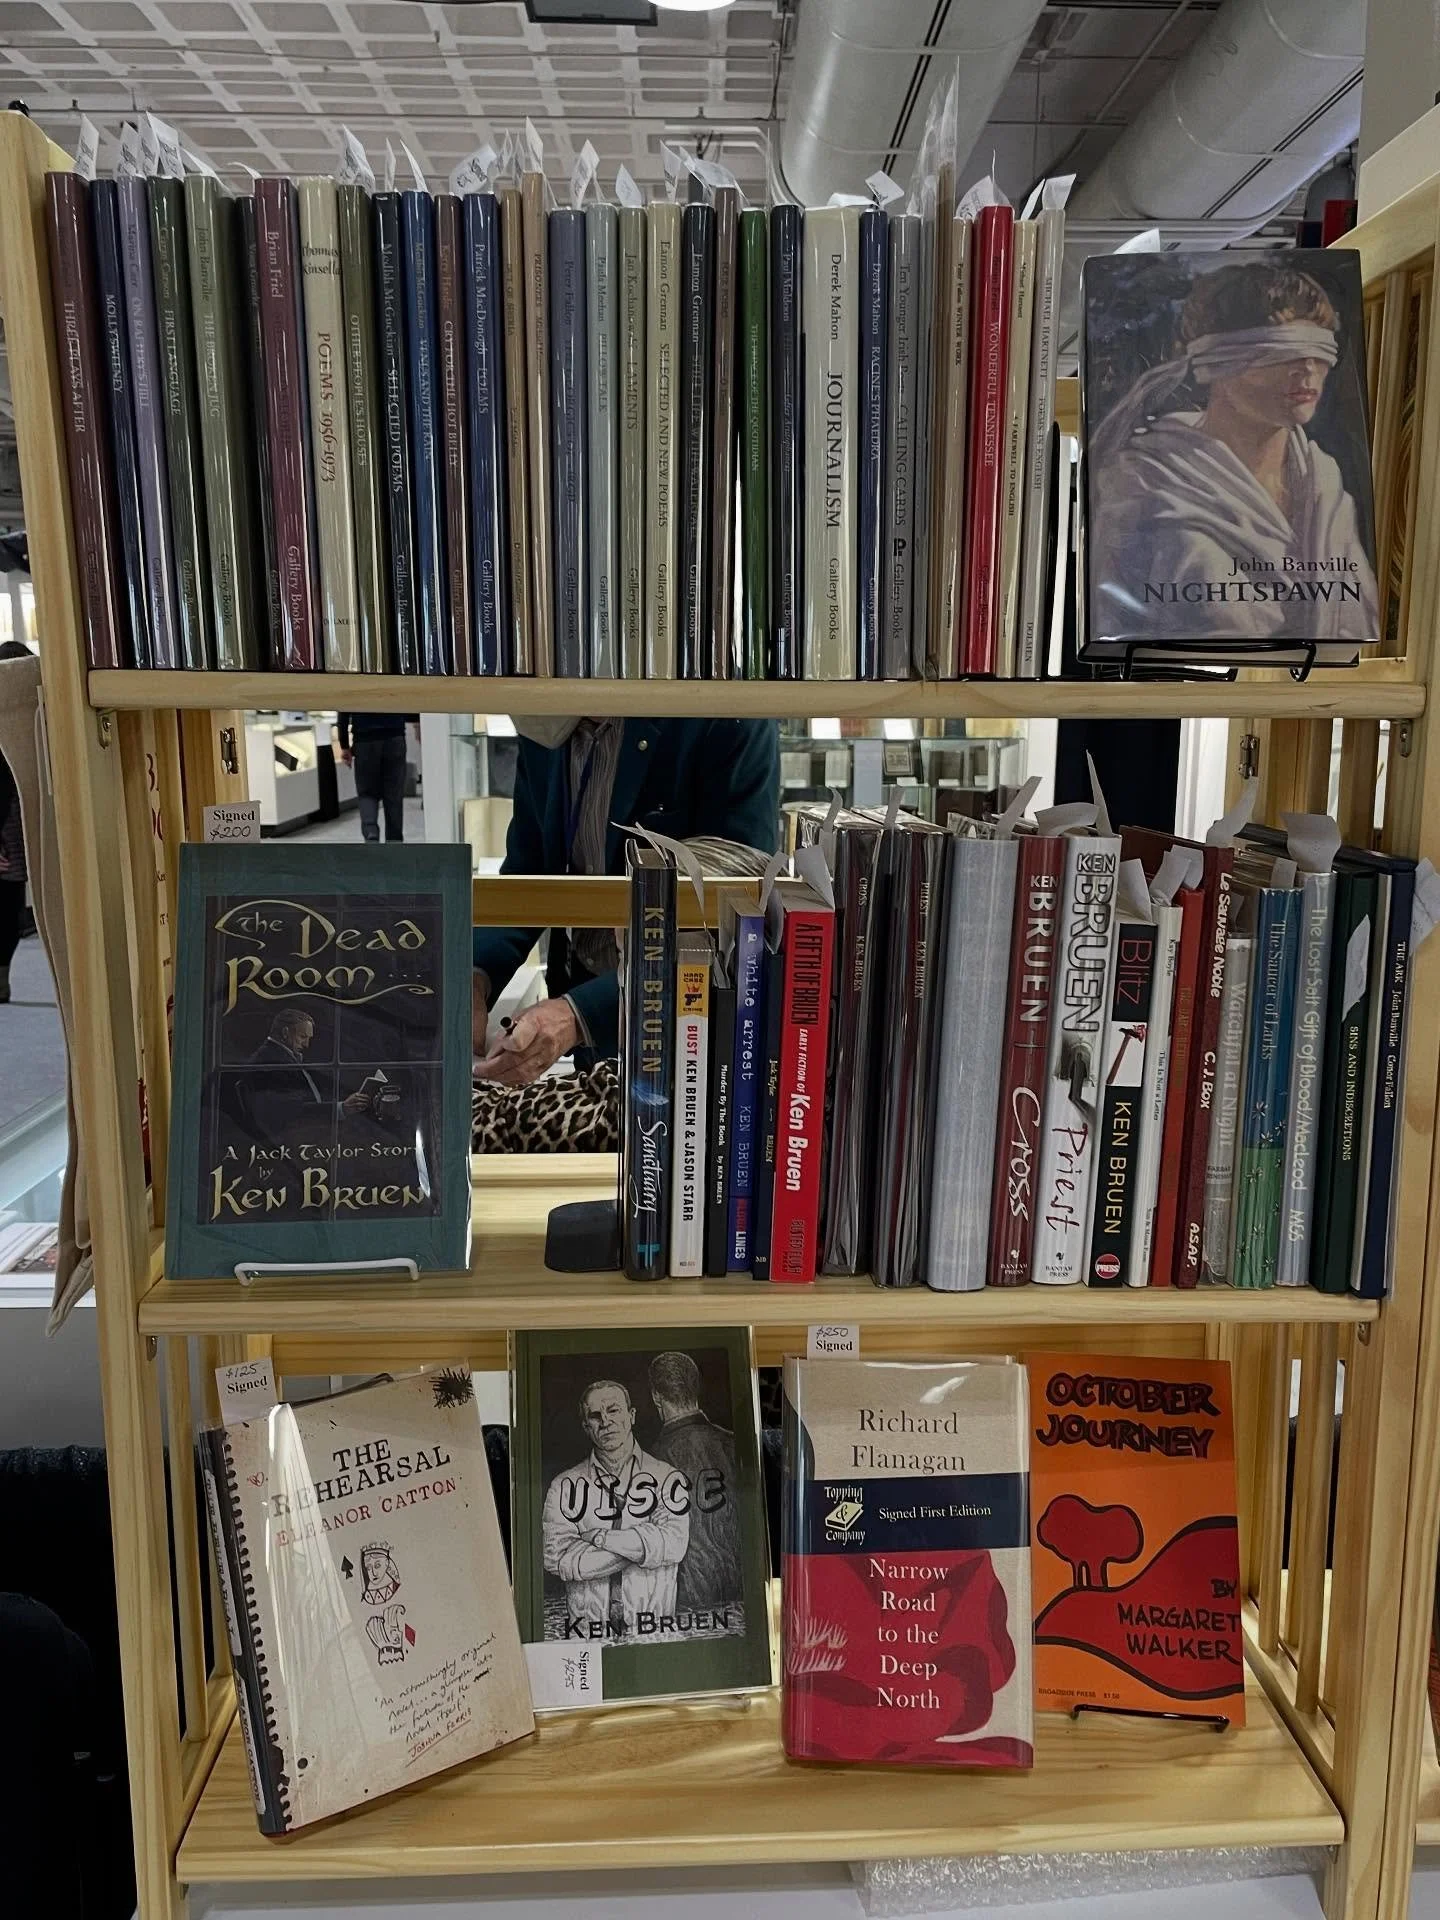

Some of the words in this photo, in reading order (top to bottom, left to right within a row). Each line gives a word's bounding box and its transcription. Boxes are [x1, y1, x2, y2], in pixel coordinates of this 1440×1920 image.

[475, 244, 486, 282] Patrick
[660, 240, 671, 279] Eamon
[830, 254, 842, 292] Derek
[899, 264, 911, 283] Ten
[660, 283, 670, 330] Grennan
[691, 295, 702, 343] Grennan
[830, 296, 842, 340] Mahon
[871, 296, 881, 333] Mahon
[896, 287, 909, 333] Younger
[898, 337, 909, 361] Irish
[987, 321, 999, 398] WONDERFUL
[318, 332, 334, 400] POEMS
[659, 343, 670, 410] SELECTED
[870, 346, 881, 399] RACINE'S
[659, 415, 670, 445] AND
[896, 404, 908, 473] CALLING
[826, 372, 843, 528] JOURNALISM
[658, 483, 669, 527] POEMS
[895, 477, 907, 526] CARDS
[287, 545, 299, 589] Gallery
[480, 559, 492, 597] Gallery
[656, 563, 667, 600] Gallery
[688, 564, 699, 601] Gallery
[826, 558, 839, 600] Gallery
[1228, 557, 1275, 576] John
[1283, 557, 1359, 572] Banville
[627, 567, 639, 605] Gallery
[1144, 581, 1362, 603] NIGHTSPAWN
[292, 594, 304, 630] Books
[483, 602, 493, 633] Books
[629, 608, 639, 639] Books
[658, 605, 668, 636] Books
[689, 605, 699, 637] Books
[829, 605, 840, 640] Books
[892, 606, 904, 639] Books
[213, 810, 255, 822] Signed
[210, 826, 251, 840] $200
[1077, 853, 1116, 873] KEN
[857, 877, 868, 906] CROSS
[1030, 875, 1059, 888] KEN
[1219, 872, 1233, 891] Le
[919, 881, 930, 916] PRIEST
[288, 903, 427, 959] Dead
[643, 907, 664, 961] KEN
[747, 932, 758, 943] a
[795, 923, 823, 932] A
[1214, 893, 1231, 953] Sauvage
[1270, 920, 1287, 948] The
[1309, 906, 1328, 936] The
[793, 935, 822, 968] FIFTH
[854, 935, 865, 957] KEN
[916, 940, 927, 962] KEN
[1019, 891, 1057, 1021] BRUEN
[1062, 873, 1115, 1032] BRUEN
[1308, 941, 1324, 969] Lost
[1396, 941, 1406, 960] THE
[225, 956, 376, 1010] Room
[744, 954, 759, 1007] white
[792, 972, 821, 986] OF
[1116, 938, 1153, 1005] Blitz
[1210, 956, 1225, 998] Noble
[1265, 950, 1283, 997] Saucer
[1394, 962, 1405, 984] ARK
[1304, 972, 1323, 1006] Salt
[1391, 990, 1402, 1011] John
[791, 987, 820, 1025] BRUEN
[1263, 1003, 1279, 1018] of
[642, 980, 663, 1073] BRUEN
[686, 1025, 698, 1055] BUST
[798, 1028, 808, 1050] EARLY
[1221, 982, 1247, 1066] Watchful
[1261, 1020, 1278, 1061] Larks
[1298, 1010, 1320, 1040] Gift
[1348, 1026, 1359, 1050] SINS
[1388, 1012, 1400, 1047] Banville
[741, 1019, 756, 1081] arrest
[797, 1053, 808, 1080] FICTION
[1204, 1051, 1216, 1067] C.
[1296, 1044, 1316, 1062] of
[1347, 1052, 1358, 1077] AND
[686, 1060, 698, 1083] KEN
[1202, 1068, 1213, 1079] J.
[1223, 1071, 1237, 1090] at
[1386, 1054, 1397, 1080] Conor
[796, 1083, 806, 1094] OF
[1200, 1081, 1213, 1109] Box
[1383, 1081, 1394, 1108] Fallon
[685, 1087, 696, 1126] BRUEN
[718, 1107, 727, 1123] The
[739, 1105, 751, 1132] KEN
[788, 1094, 811, 1130] Ken
[1215, 1095, 1238, 1146] Night
[1342, 1080, 1355, 1161] INDISCRETIONS
[685, 1131, 695, 1139] &
[1111, 1101, 1132, 1147] KEN
[1291, 1064, 1317, 1191] Blood/MacLeod
[222, 1145, 239, 1160] A
[248, 1144, 292, 1168] Jack
[298, 1144, 364, 1161] Taylor
[371, 1142, 421, 1157] Stor
[629, 1115, 669, 1219] Sanctuary
[684, 1143, 695, 1180] JASON
[736, 1142, 750, 1188] BRUEN
[786, 1136, 809, 1191] Bruen
[1008, 1086, 1041, 1222] Cross
[1045, 1122, 1089, 1234] Priest
[683, 1185, 694, 1221] STARR
[1103, 1156, 1127, 1234] BRUEN
[815, 1340, 853, 1352] Signed
[816, 1327, 849, 1340] $250
[225, 1364, 258, 1378] $125
[227, 1376, 268, 1394] Signed
[1045, 1372, 1222, 1417] OCTOBER
[858, 1409, 959, 1435] Richard
[1036, 1413, 1215, 1459] JOURNEY
[332, 1439, 392, 1472] THE
[850, 1444, 966, 1474] Flanagan
[380, 1477, 457, 1512] CATTON
[824, 1485, 863, 1505] Topping
[836, 1504, 848, 1518] &
[879, 1507, 917, 1522] Signed
[920, 1506, 945, 1518] First
[949, 1504, 992, 1517] Edition
[825, 1529, 866, 1546] Company
[869, 1558, 949, 1581] Narrow
[881, 1590, 936, 1612] Road
[1213, 1579, 1238, 1599] BY
[1117, 1602, 1242, 1632] MARGARET
[878, 1626, 898, 1642] to
[906, 1623, 939, 1645] the
[1126, 1633, 1241, 1666] WALKER
[579, 1651, 590, 1690] Signed
[880, 1654, 938, 1681] Deep
[877, 1686, 940, 1709] North
